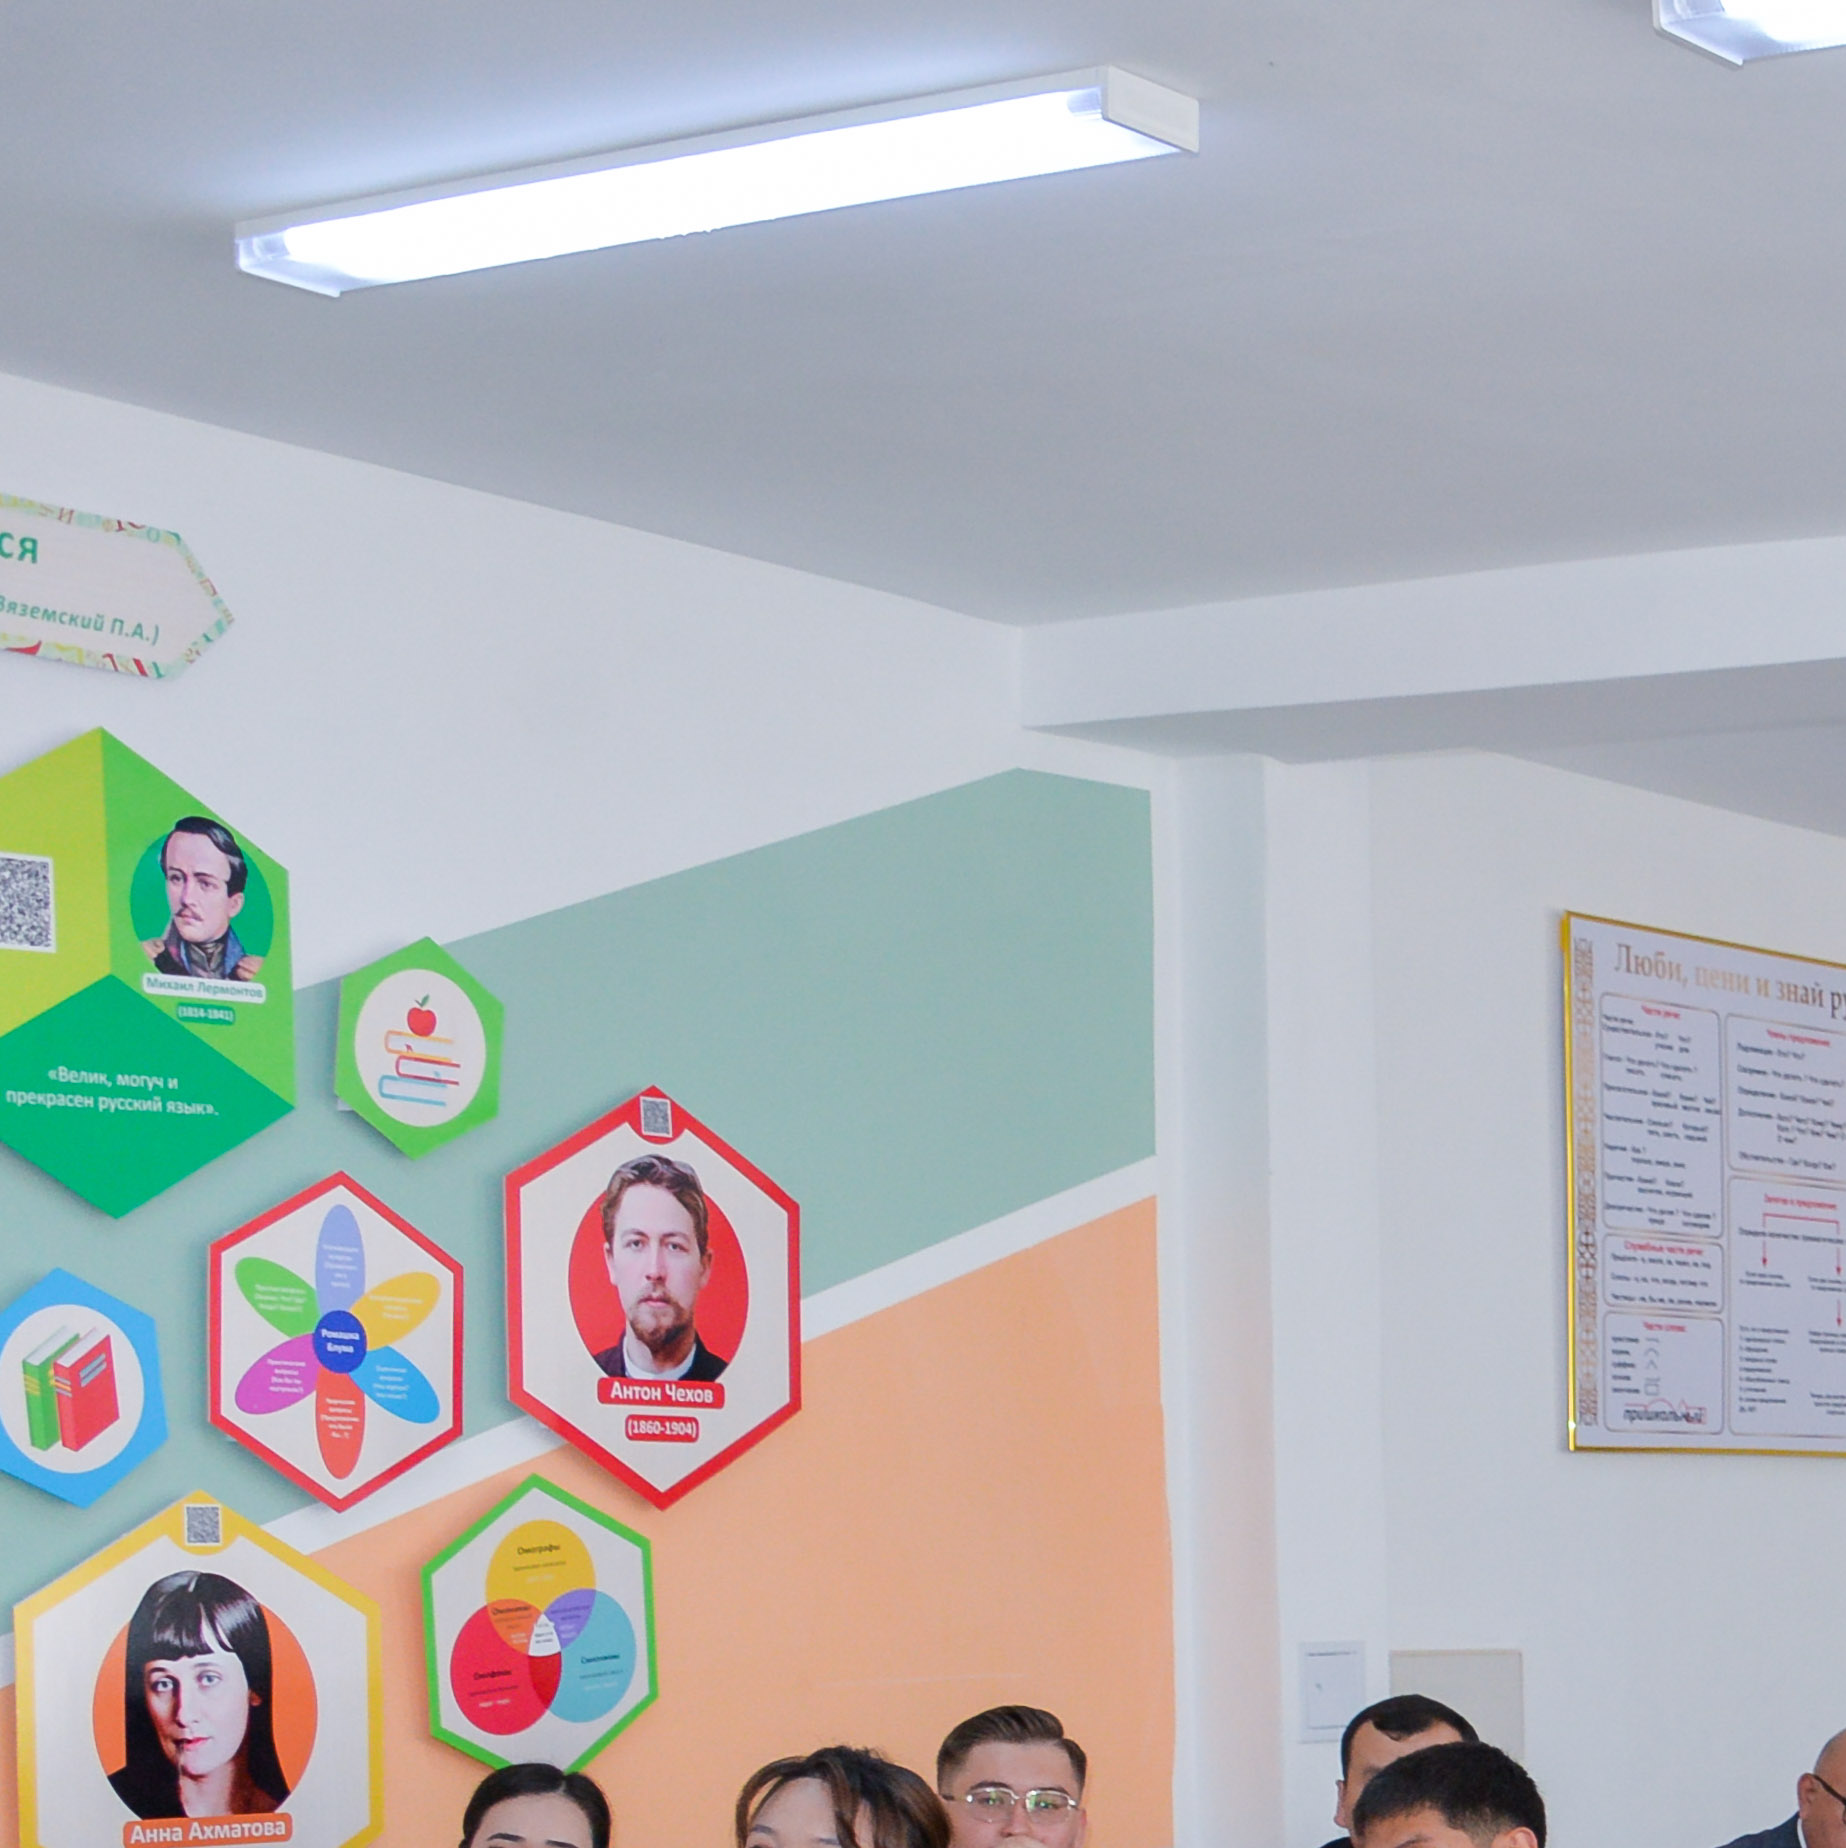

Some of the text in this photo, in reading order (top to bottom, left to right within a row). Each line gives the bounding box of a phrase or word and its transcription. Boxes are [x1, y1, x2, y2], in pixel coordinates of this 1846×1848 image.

[110, 618, 160, 646] П.А.)
[146, 977, 263, 999] Михаил Лермонтов
[1614, 943, 1688, 989] Люби,
[1695, 963, 1750, 997] цени
[1757, 978, 1770, 997] и
[1776, 983, 1824, 1009] знай
[48, 1065, 179, 1092] «Велик, могуч и
[5, 1090, 94, 1109] прекрасен
[98, 1095, 162, 1114] русский
[610, 1381, 714, 1404] Антон Чехов
[627, 1417, 699, 1439] (1860-1904)
[130, 1818, 286, 1845] Анна Ахматова
